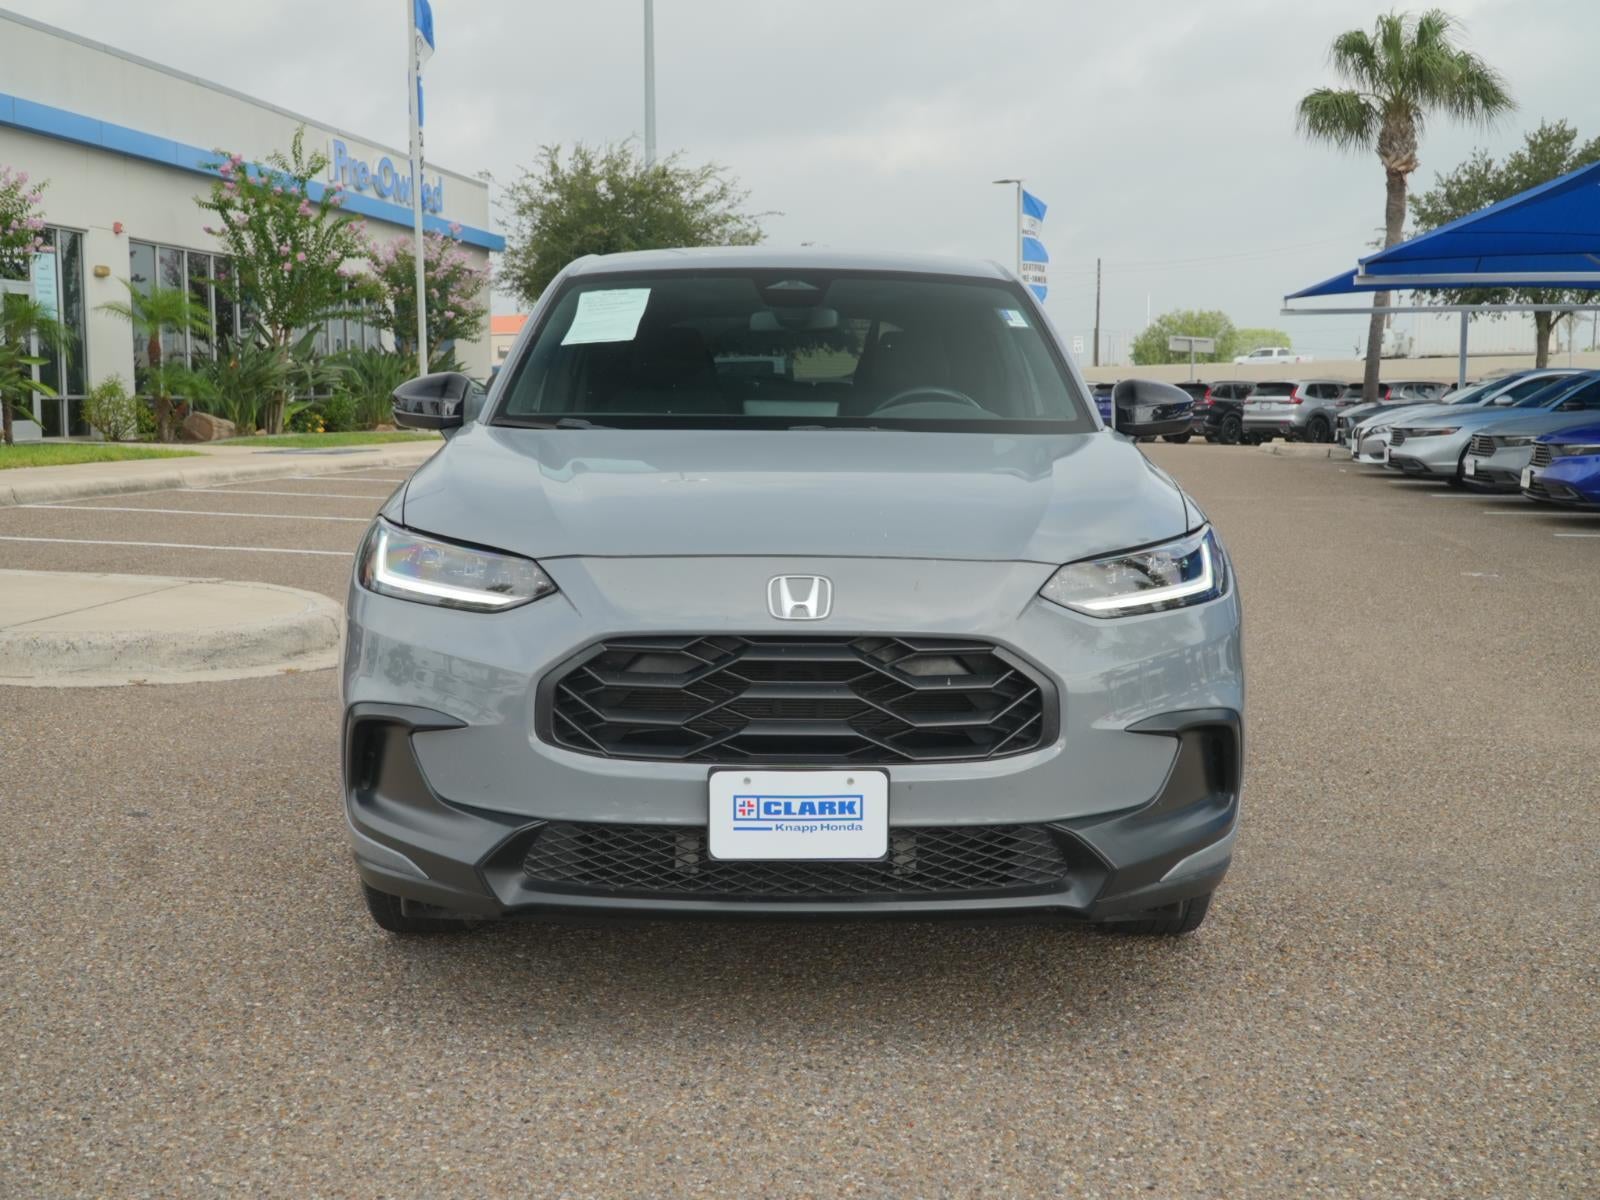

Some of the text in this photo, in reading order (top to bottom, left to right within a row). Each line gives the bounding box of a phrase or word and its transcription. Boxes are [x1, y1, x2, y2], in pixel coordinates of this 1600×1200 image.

[330, 138, 443, 213] Pre-Owed
[763, 800, 857, 816] CLARK
[775, 823, 863, 833] Knapp Honda
